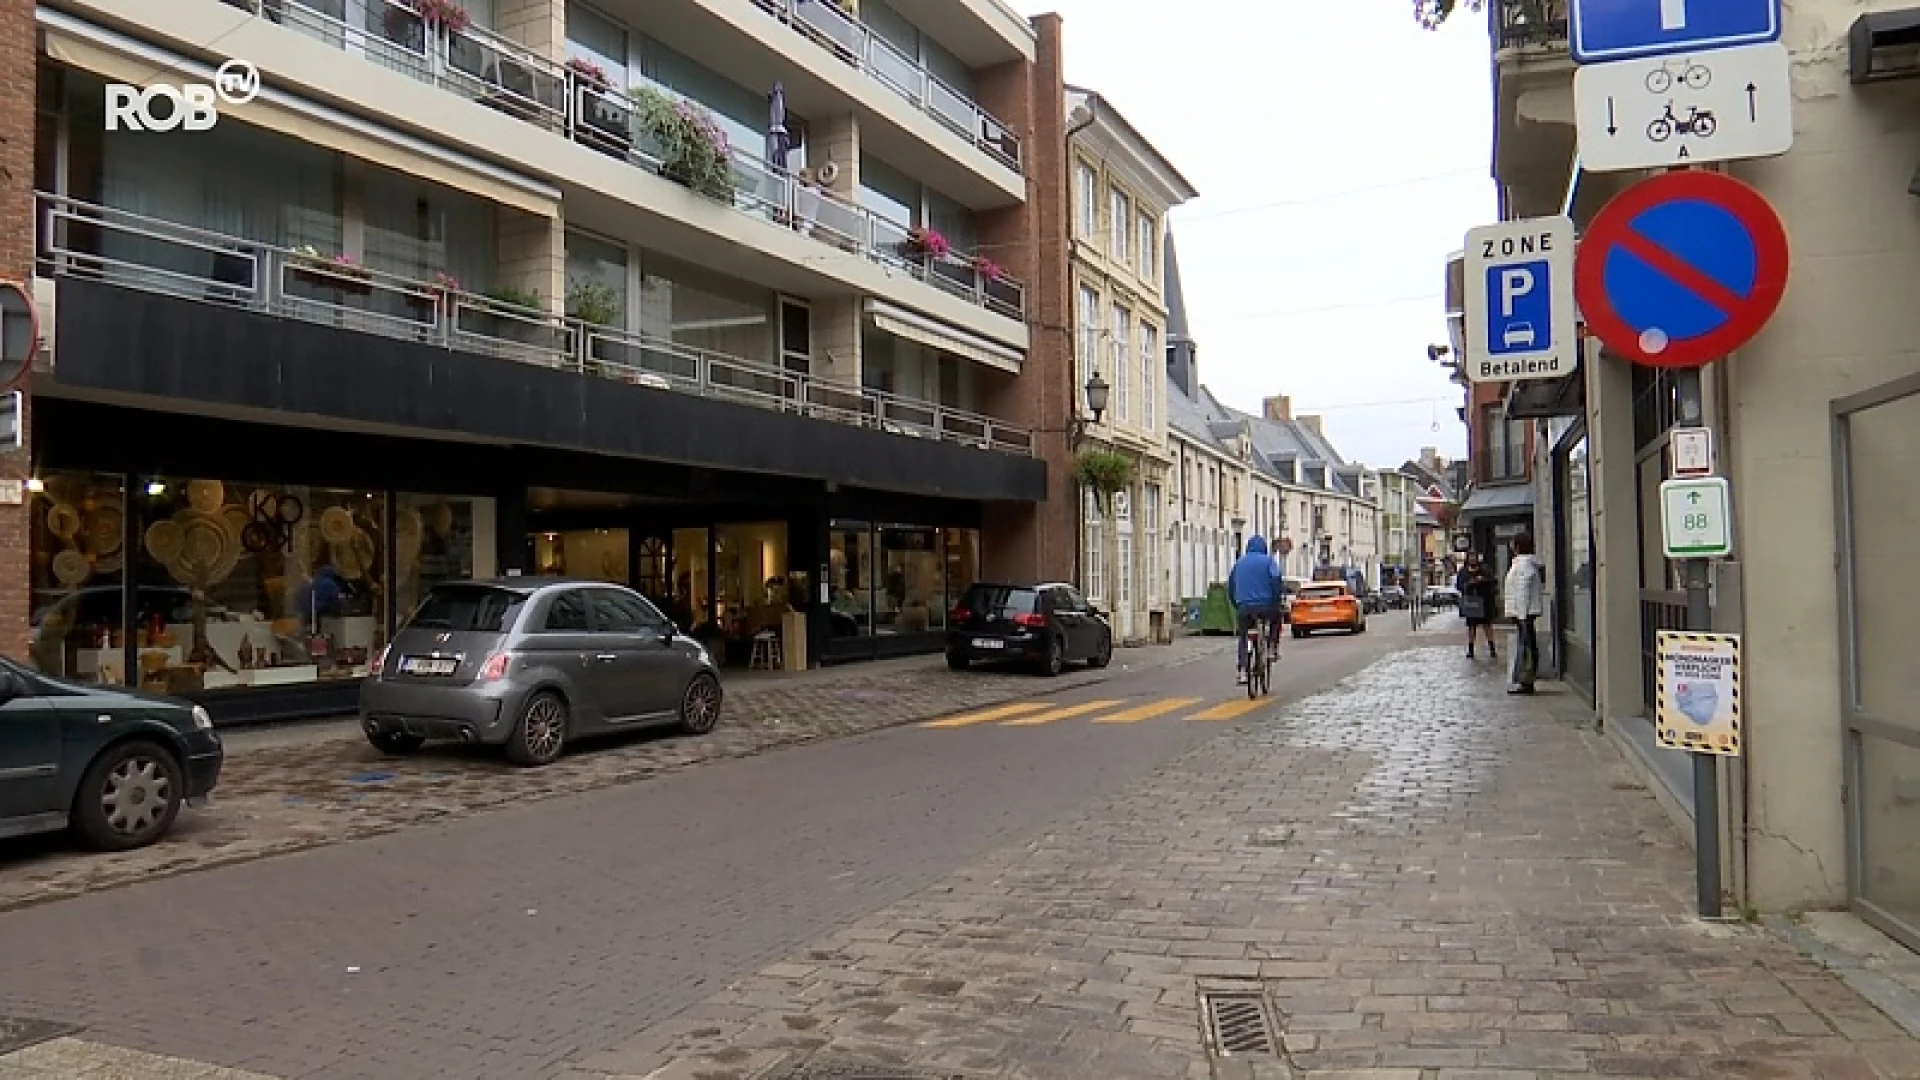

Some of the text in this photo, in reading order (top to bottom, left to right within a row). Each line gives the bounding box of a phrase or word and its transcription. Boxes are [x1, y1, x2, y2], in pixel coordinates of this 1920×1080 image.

[1679, 144, 1688, 157] A
[1482, 232, 1553, 258] ZONE
[1502, 268, 1534, 317] P
[1480, 356, 1559, 376] Betalend
[1684, 513, 1707, 530] 88
